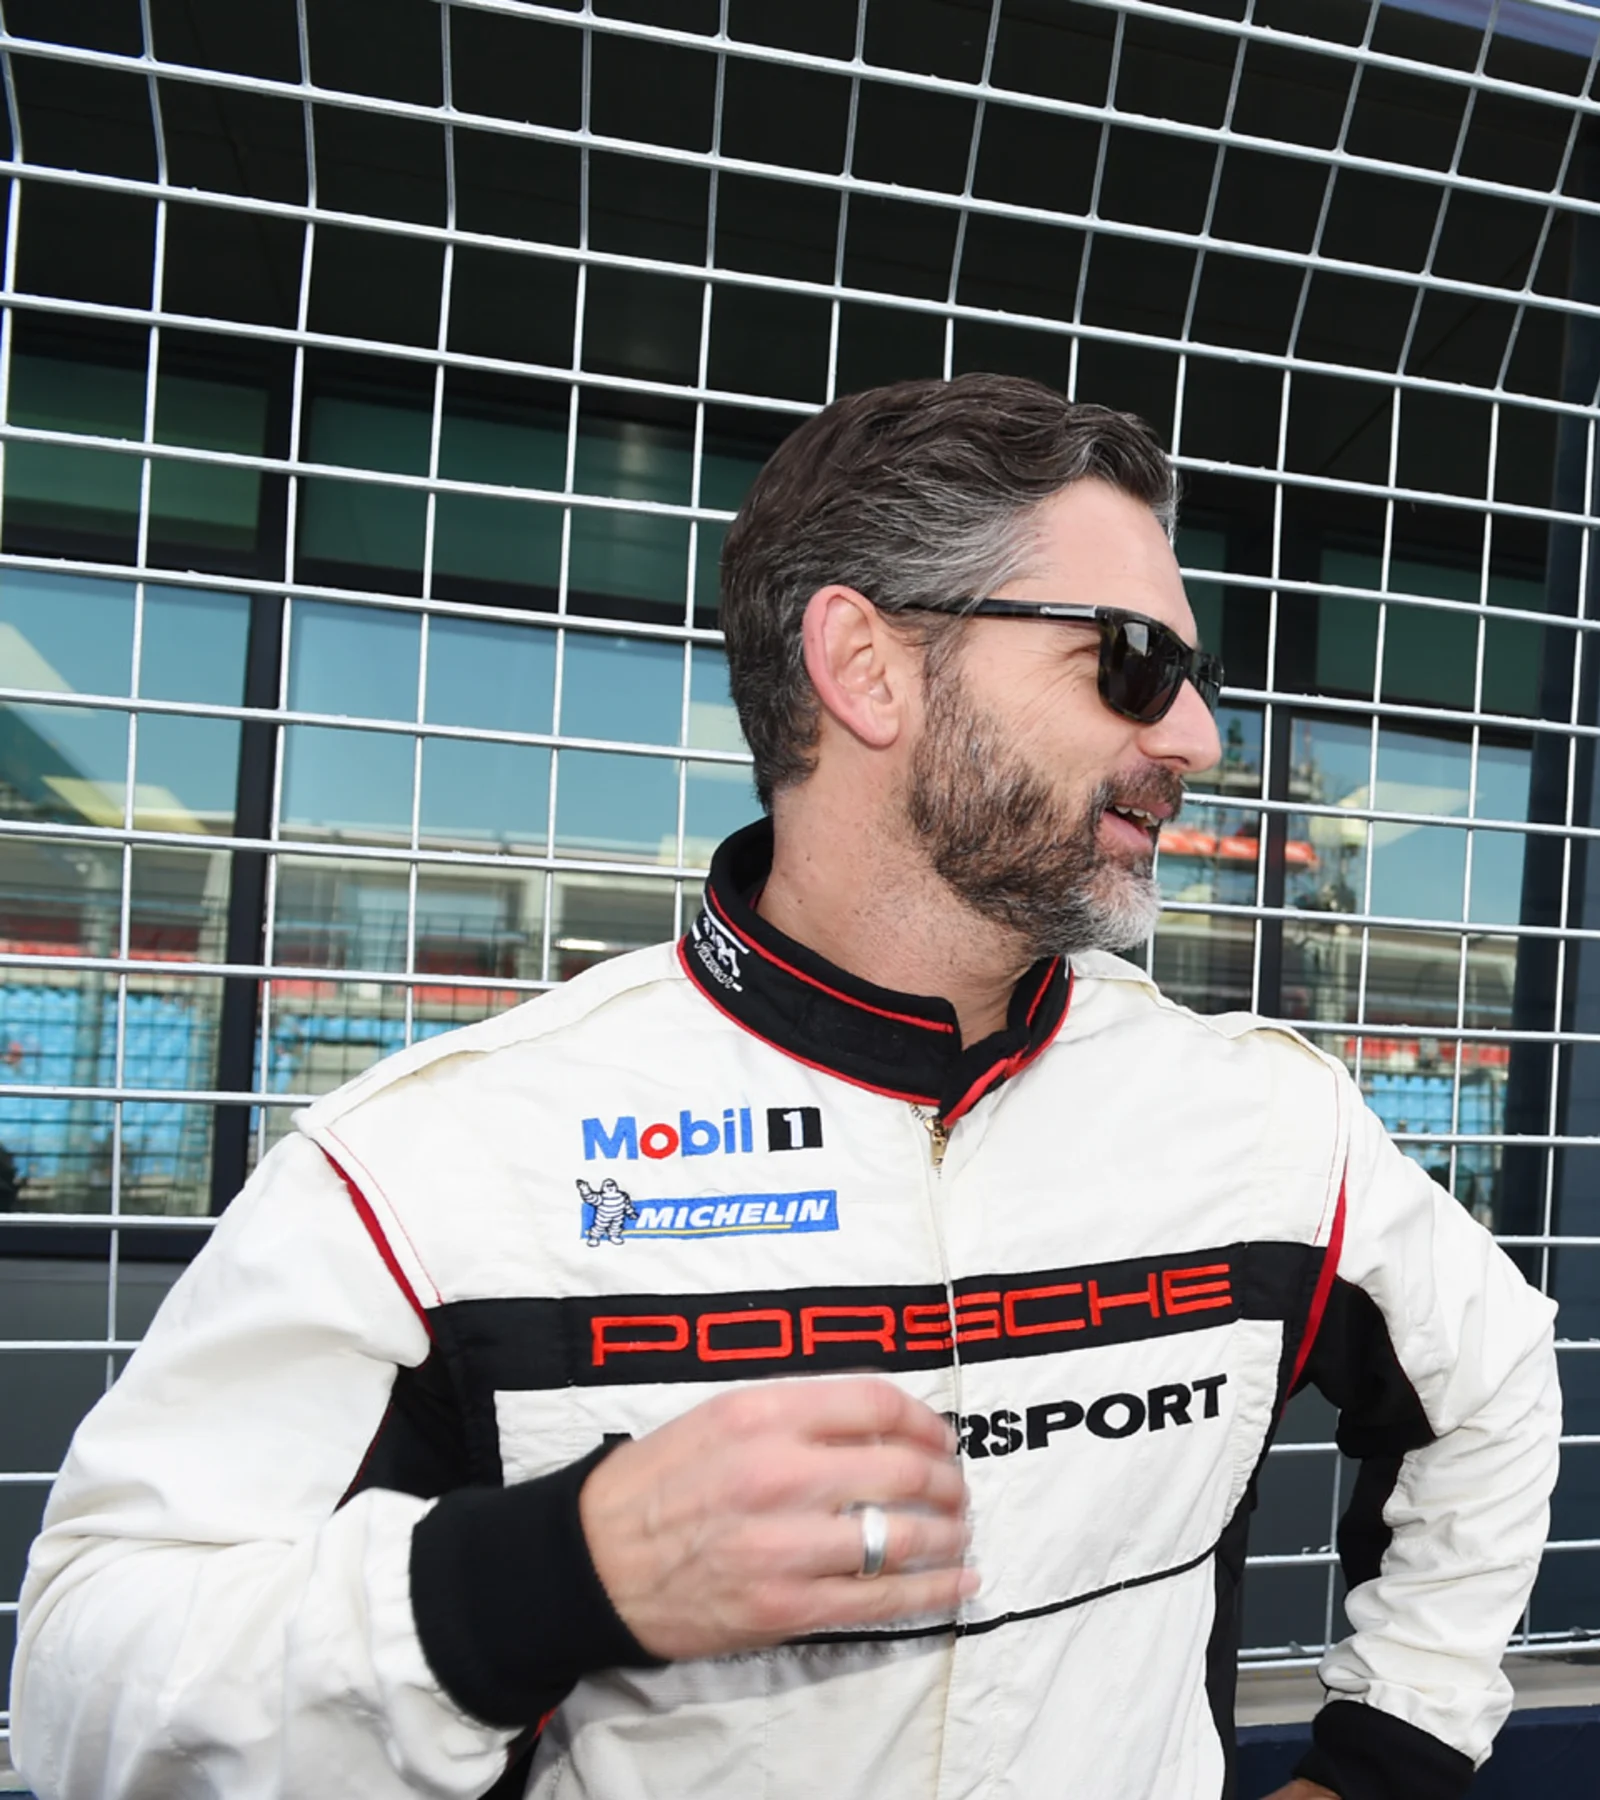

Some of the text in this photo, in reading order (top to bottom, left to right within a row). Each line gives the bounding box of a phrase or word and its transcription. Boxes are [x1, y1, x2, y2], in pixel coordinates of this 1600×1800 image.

[581, 1108, 752, 1161] Mobil
[636, 1199, 829, 1230] MICHELIN
[591, 1263, 1233, 1366] PORSCHE
